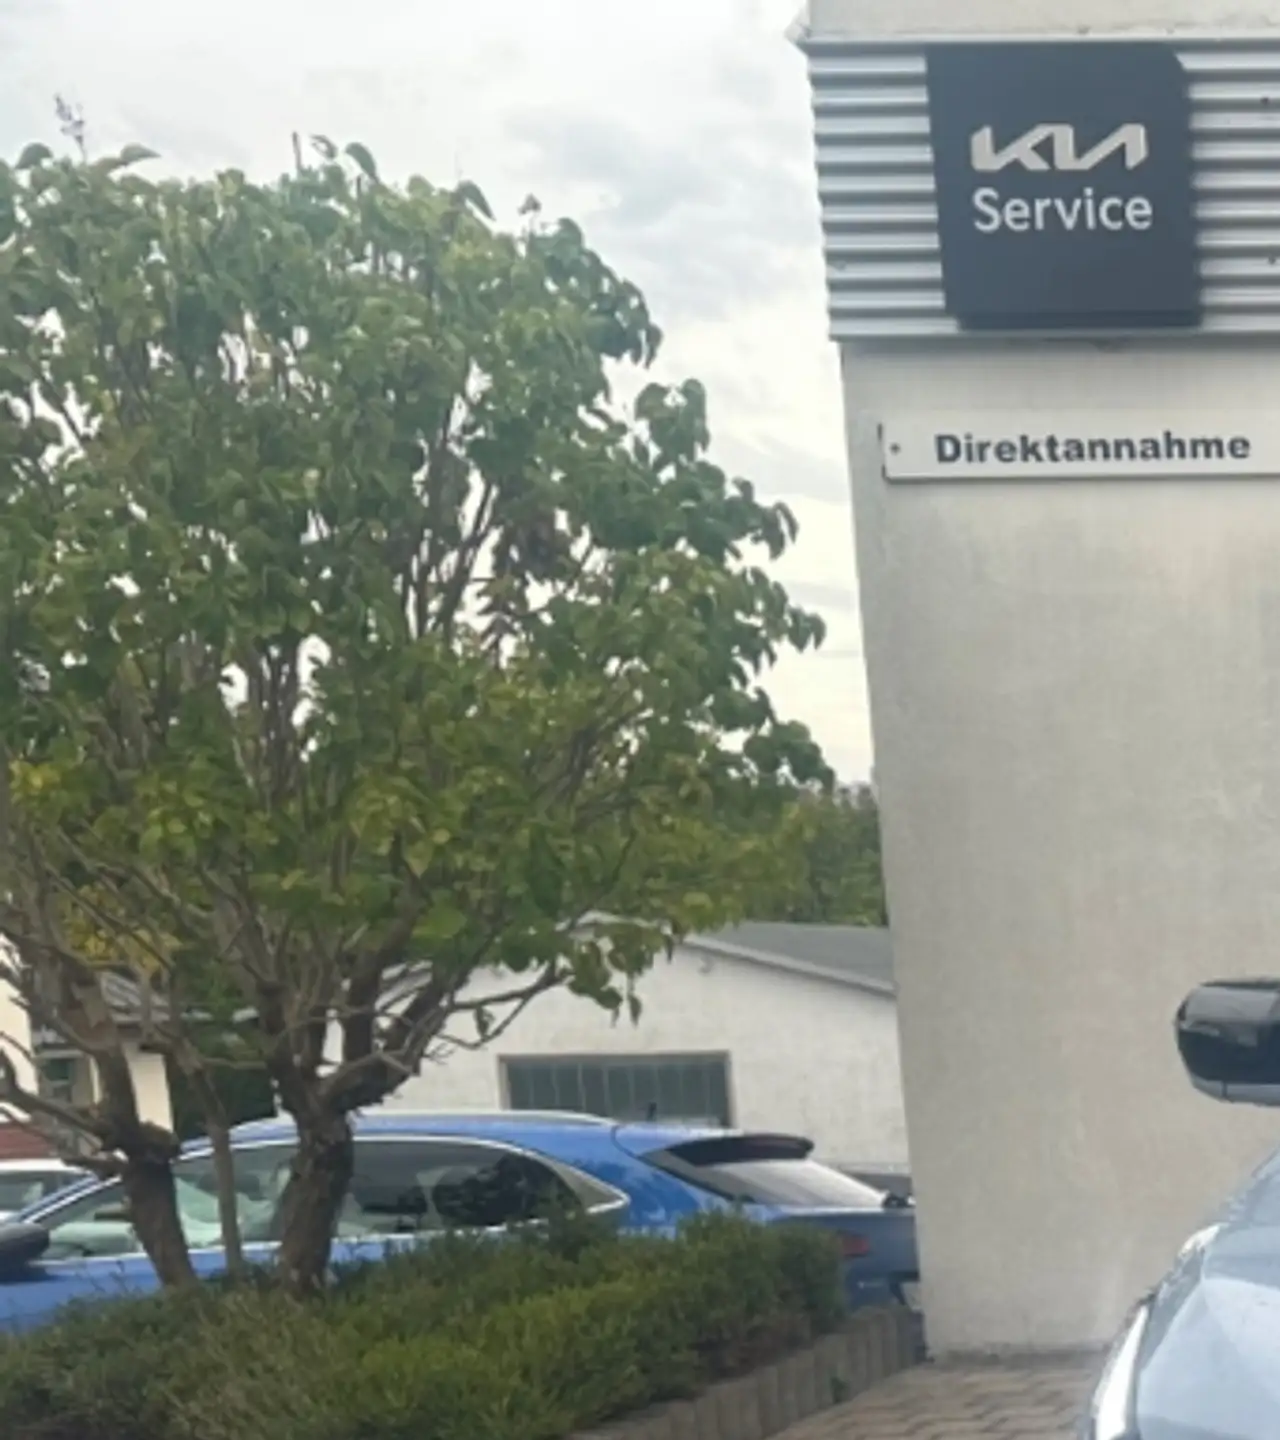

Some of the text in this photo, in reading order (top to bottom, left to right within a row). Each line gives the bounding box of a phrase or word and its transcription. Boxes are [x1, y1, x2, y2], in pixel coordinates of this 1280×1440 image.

[970, 123, 1148, 171] KIA
[972, 187, 1153, 232] Service
[934, 431, 1251, 464] Direktannahme
